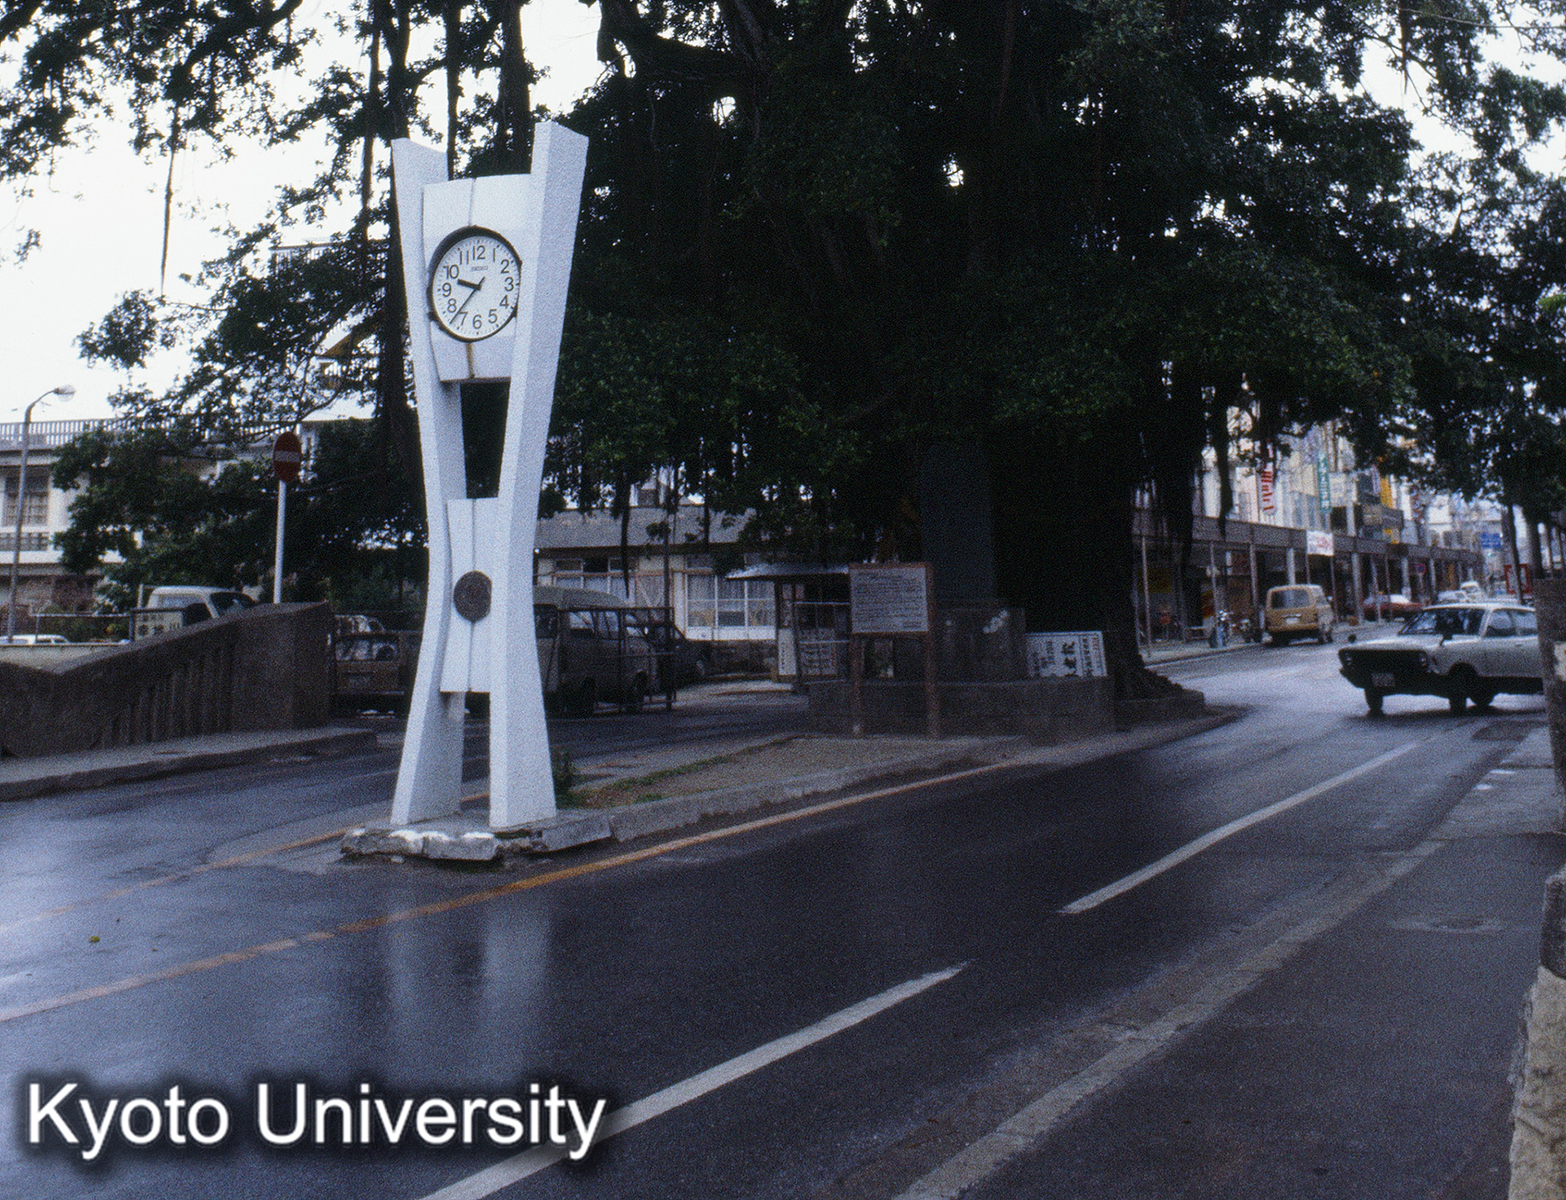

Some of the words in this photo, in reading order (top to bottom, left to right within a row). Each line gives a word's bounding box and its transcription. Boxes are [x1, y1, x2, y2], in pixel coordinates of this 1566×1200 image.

[459, 251, 469, 265] 11
[472, 245, 486, 260] 12
[443, 264, 459, 280] 10
[500, 259, 510, 274] 2
[442, 282, 452, 297] 9
[504, 277, 514, 291] 3
[447, 298, 457, 313] 8
[499, 295, 509, 309] 4
[459, 311, 468, 326] 7
[472, 314, 482, 329] 6
[488, 309, 498, 323] 5
